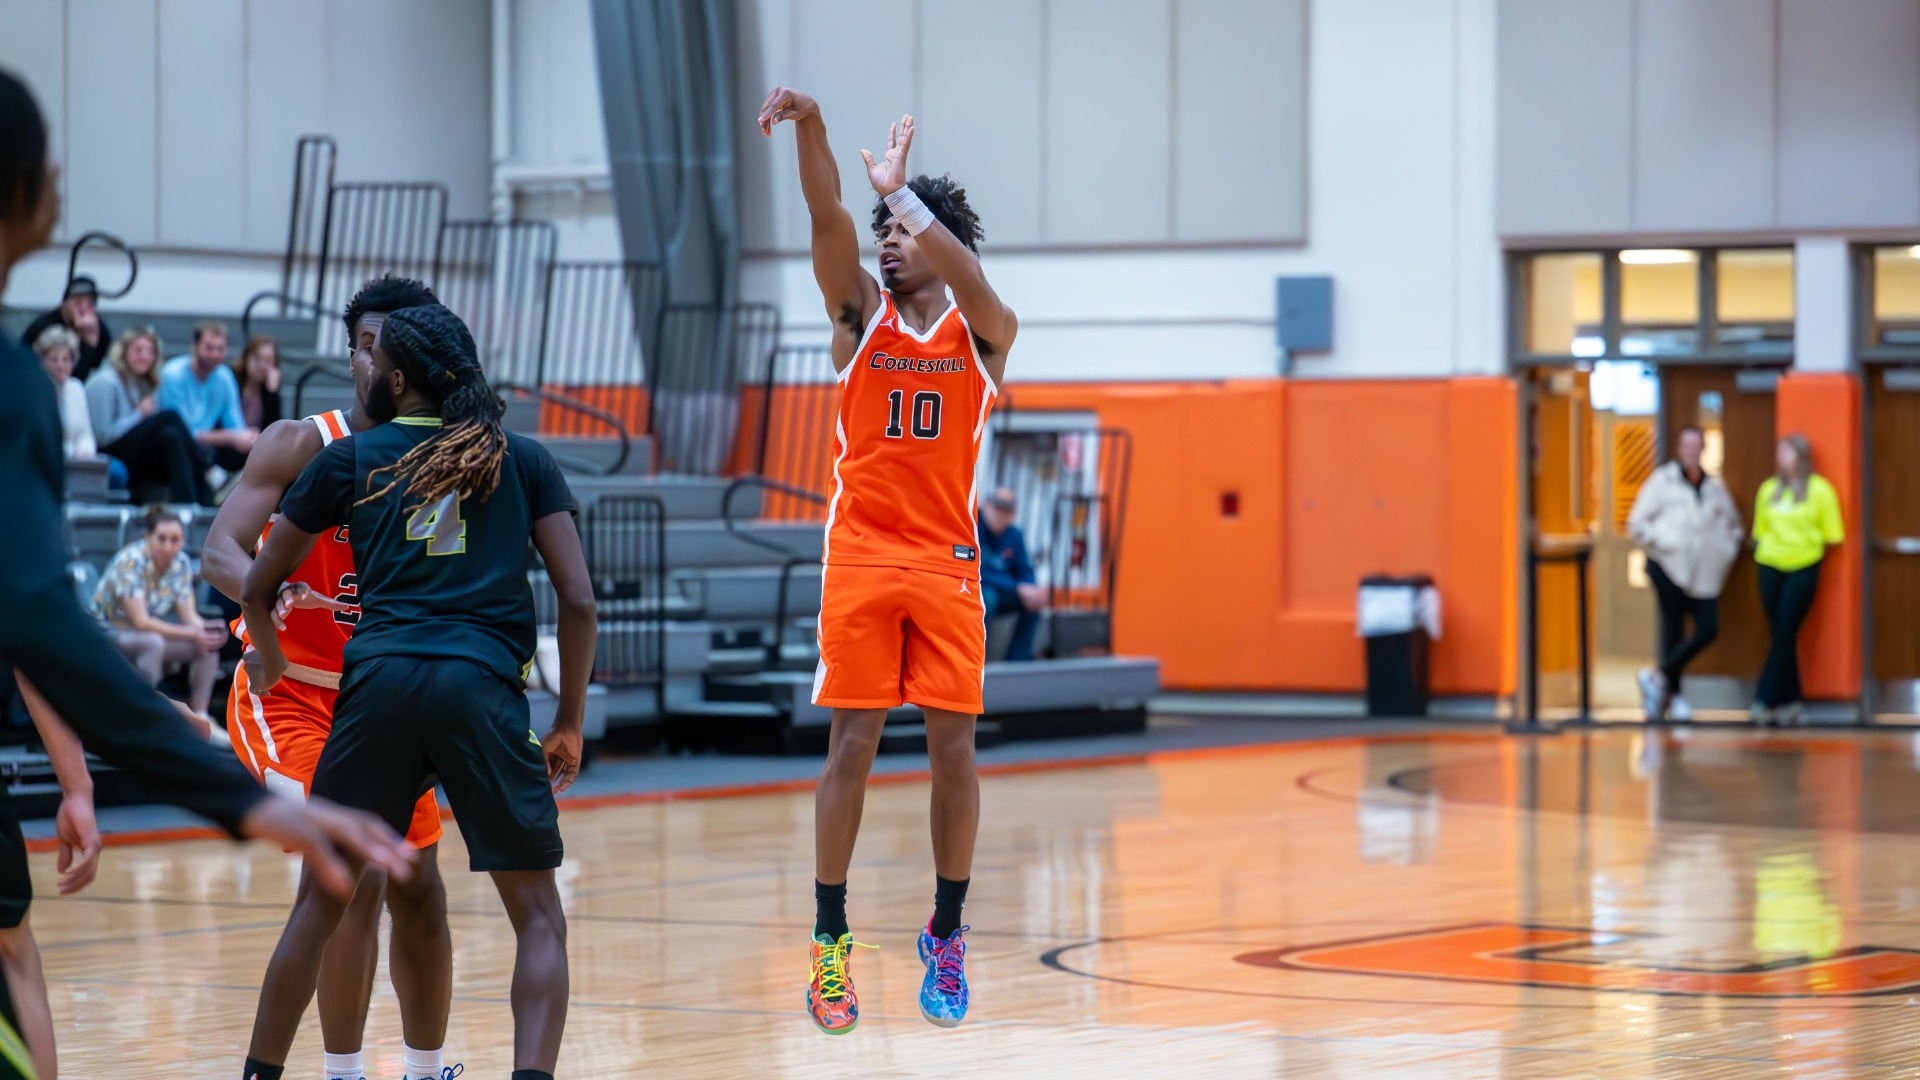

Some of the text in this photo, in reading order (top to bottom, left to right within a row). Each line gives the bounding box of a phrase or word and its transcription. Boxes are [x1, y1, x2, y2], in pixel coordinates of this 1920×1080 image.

[870, 352, 966, 373] COBLESKILL
[885, 389, 943, 439] 10
[406, 488, 466, 556] 4
